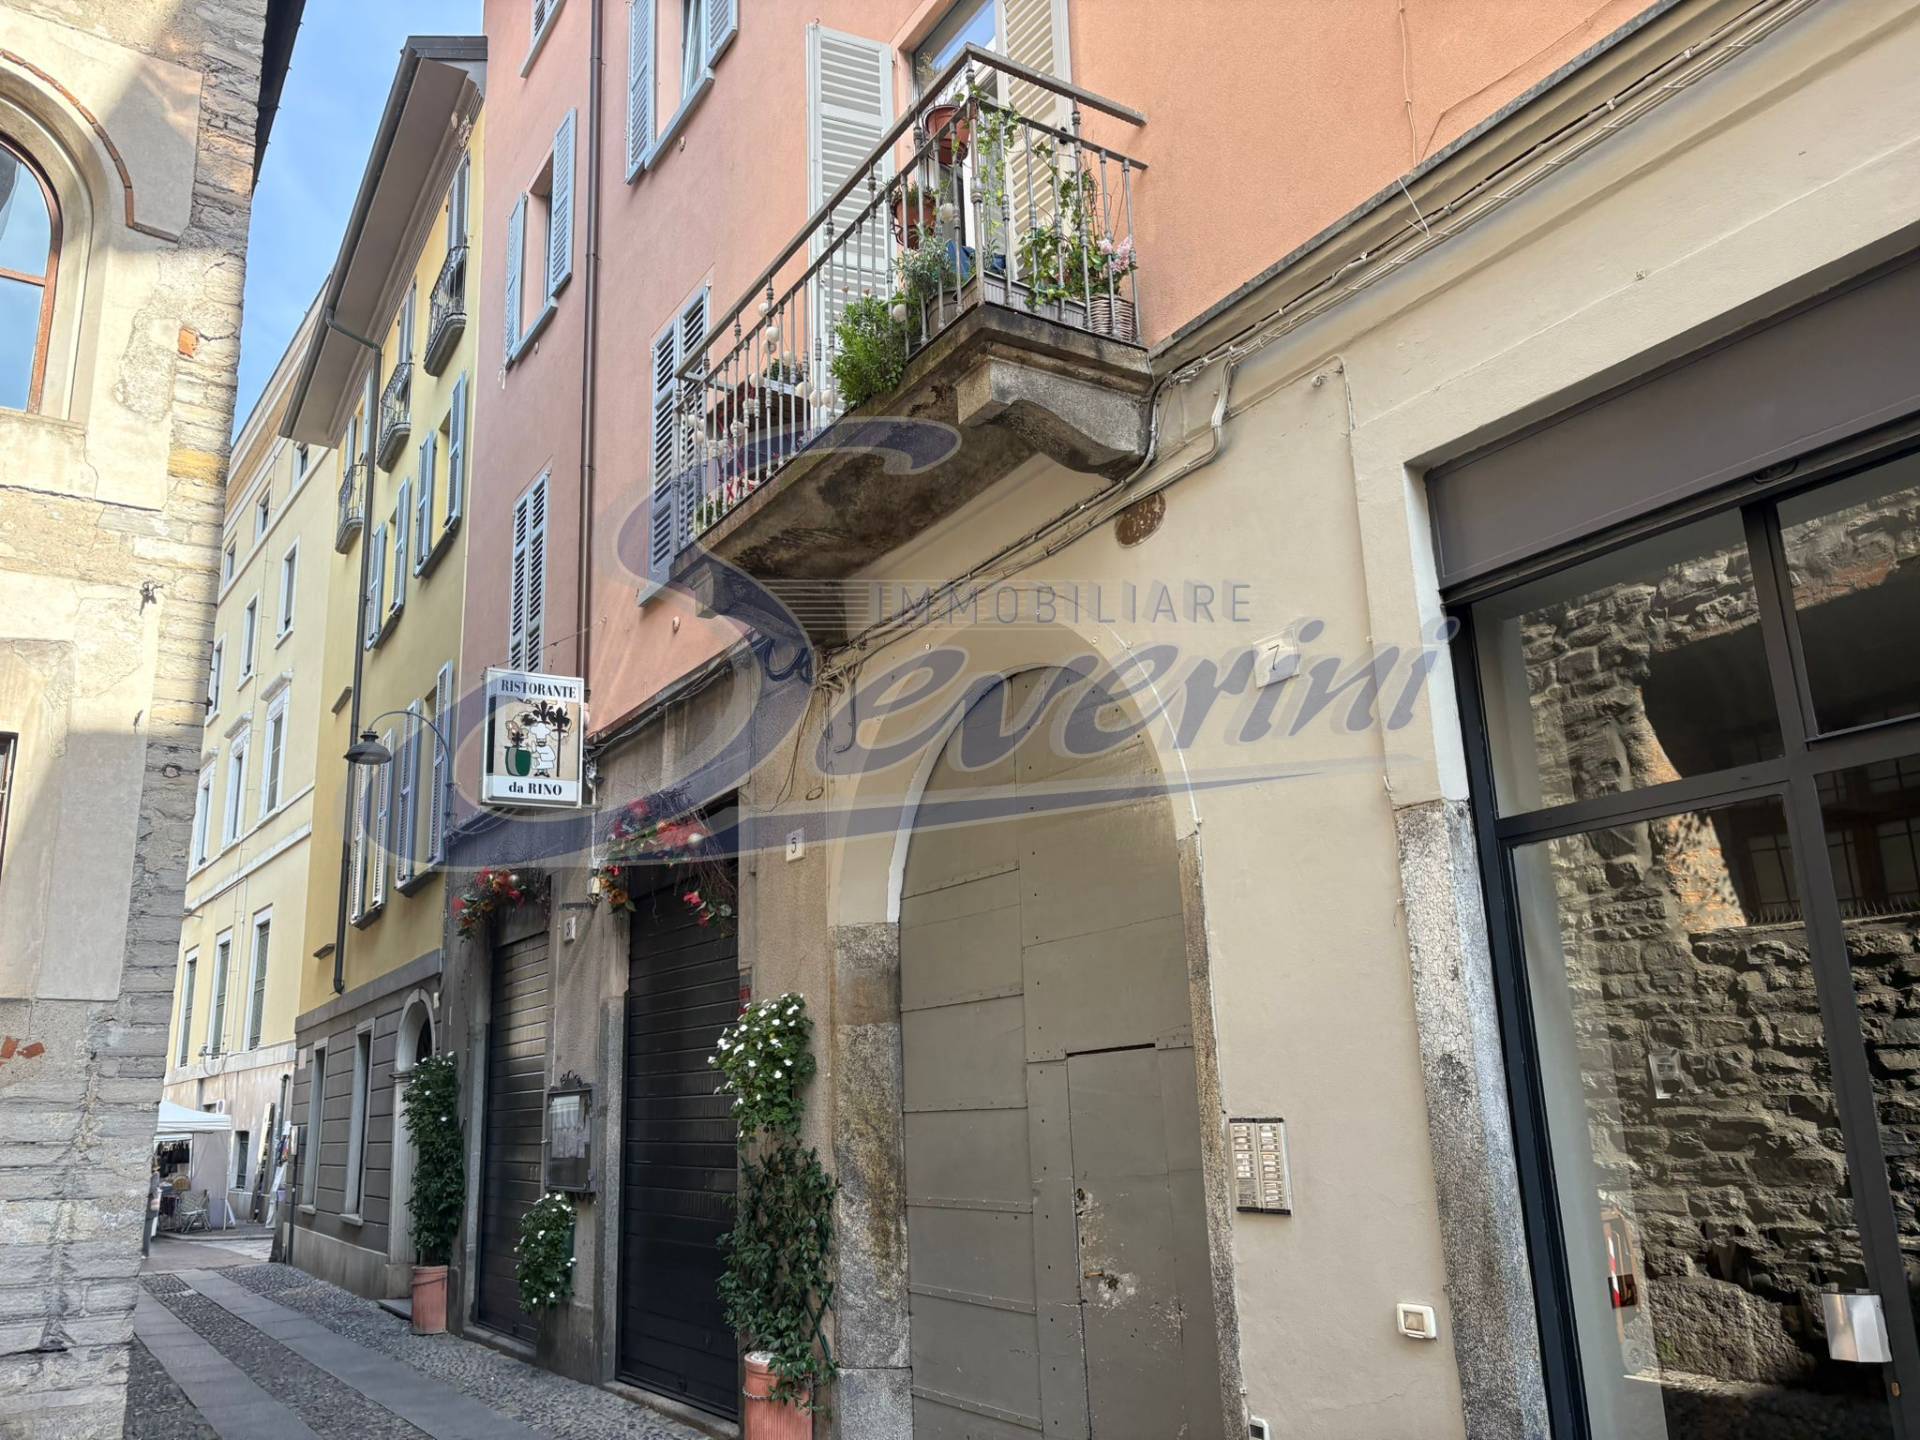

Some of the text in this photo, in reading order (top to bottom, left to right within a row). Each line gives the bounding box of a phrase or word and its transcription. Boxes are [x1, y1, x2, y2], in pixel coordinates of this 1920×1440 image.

[1267, 643, 1280, 671] 7
[500, 679, 577, 699] RISTORANTE
[508, 781, 562, 796] da RINO
